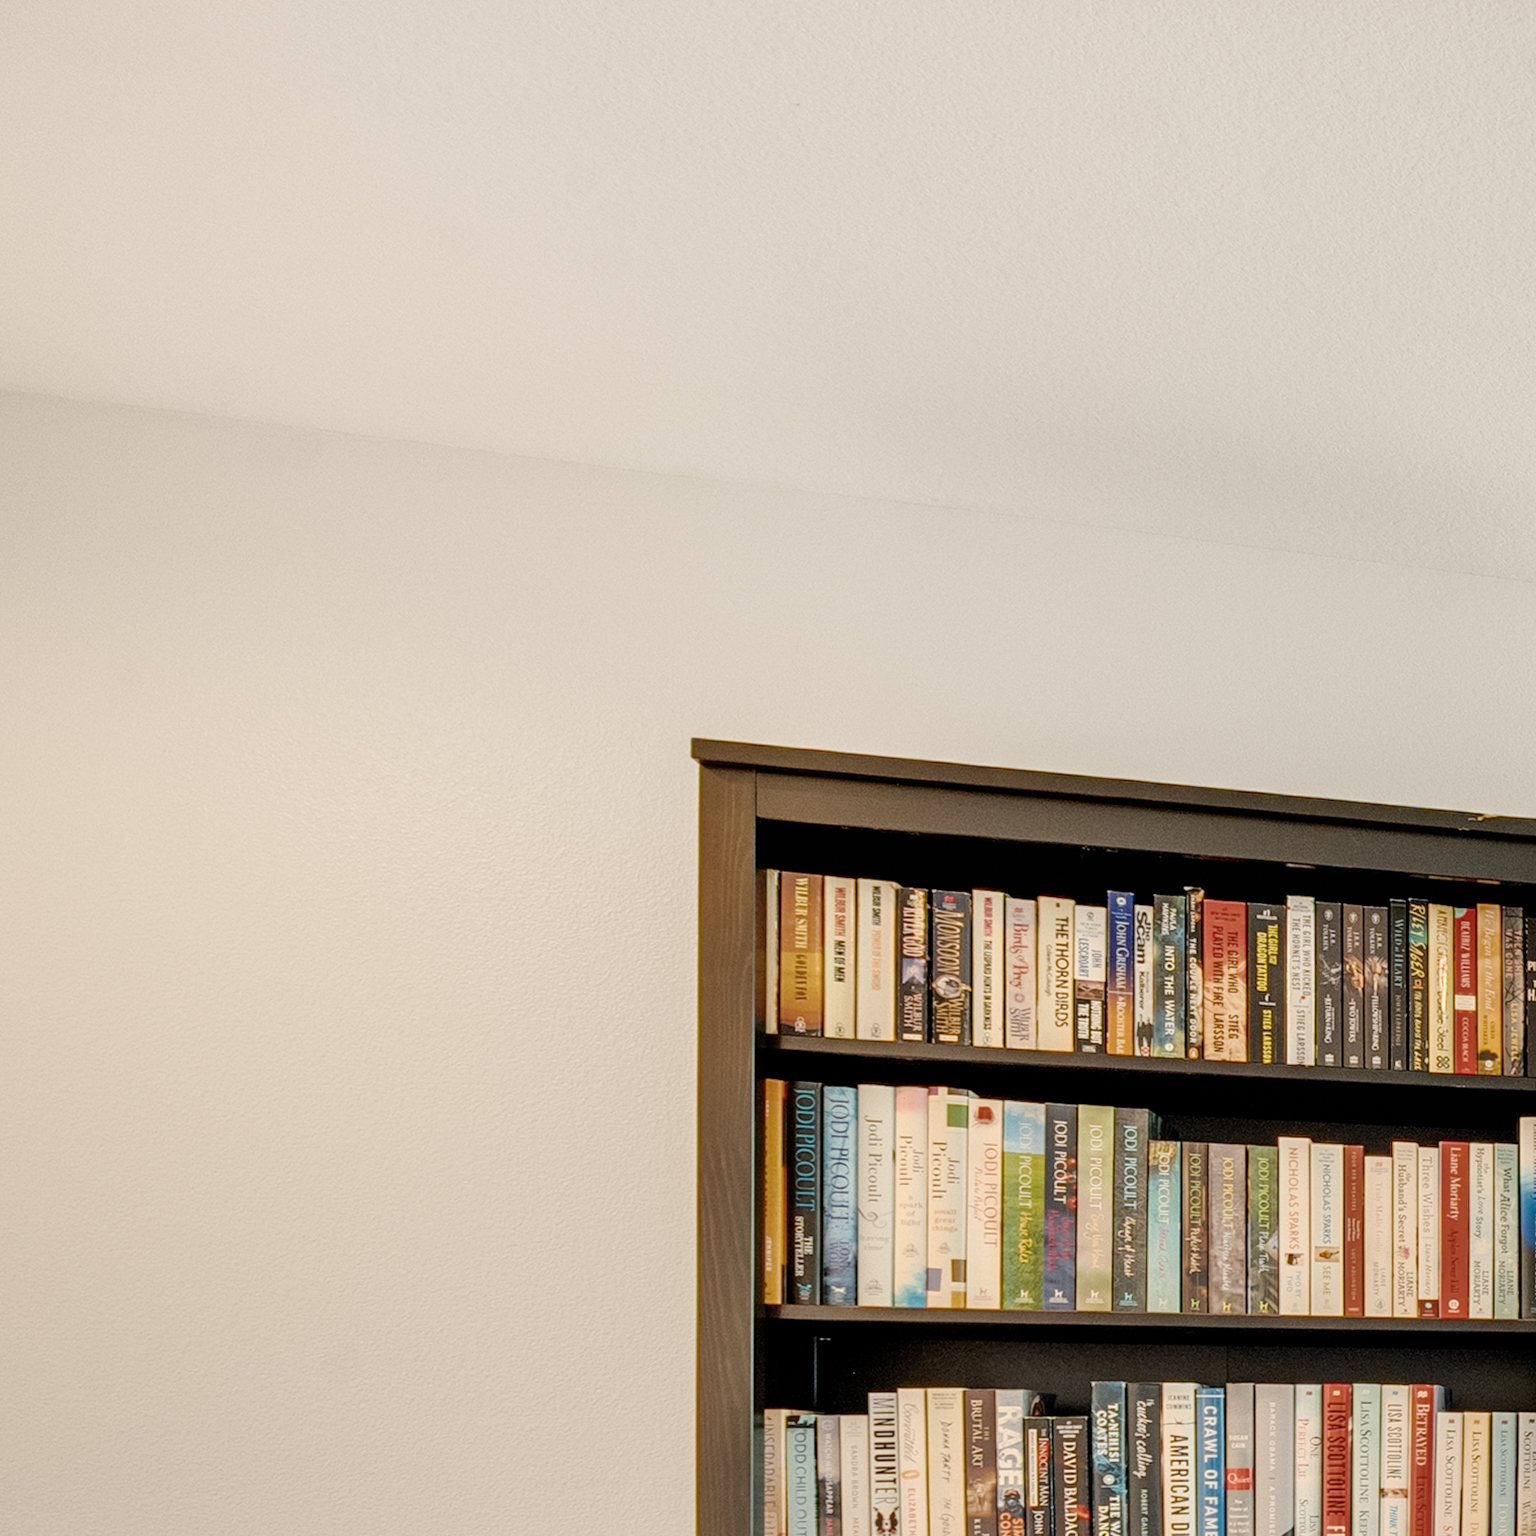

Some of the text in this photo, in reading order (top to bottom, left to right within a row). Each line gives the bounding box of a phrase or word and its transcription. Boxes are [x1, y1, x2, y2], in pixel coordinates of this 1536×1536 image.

[796, 878, 808, 949] WILBUR SMITH
[835, 888, 846, 912] WILBUR
[835, 914, 845, 936] SMITH
[1161, 903, 1169, 935] HAWKINS
[835, 940, 845, 956] MEN
[934, 909, 964, 975] MONSOON
[1116, 917, 1129, 988] JOHN GRISHAM
[1137, 911, 1146, 964] Scam
[1227, 932, 1239, 993] THE GIRL WHO
[1257, 932, 1267, 992] DRAGON TATTOO
[1411, 904, 1426, 979] RILEY SAGER
[835, 968, 845, 982] MEN
[1055, 917, 1069, 1027] THE THORN BIRDS
[1165, 945, 1175, 1035] INTO THE WATER
[1213, 926, 1224, 1007] PLAYED WITH FIRE
[934, 1001, 947, 1033] SMITH
[949, 994, 964, 1034] WILBUR
[1116, 1002, 1125, 1054] ROOSTER BAR
[1213, 1013, 1224, 1053] LARSSON
[1229, 1014, 1238, 1039] STIEG
[794, 1089, 815, 1211] JODI PICOULT
[865, 1116, 882, 1202] Jodi Picoult
[1053, 1120, 1068, 1147] JODI
[1450, 1147, 1461, 1175] Liane
[1018, 1155, 1032, 1208] PICOULT
[1054, 1151, 1068, 1204] PICOULT
[1288, 1147, 1300, 1249] NICHOLAS SPARKS
[1422, 1157, 1433, 1233] Three Wishes
[1447, 1176, 1461, 1220] Moriarty
[1500, 1168, 1513, 1254] What Alice Forgot
[795, 1216, 804, 1277] STORYTELLER
[971, 1399, 983, 1468] BRUTAL ART
[1097, 1409, 1107, 1456] COATES
[1203, 1405, 1218, 1463] CRAWL
[1327, 1402, 1346, 1431] LISA
[1416, 1403, 1430, 1466] BETRAYED
[873, 1398, 898, 1505] MINDHUNTER
[999, 1405, 1024, 1485] RAGE
[1063, 1442, 1077, 1484] DAVID
[795, 1470, 807, 1505] CHILD
[1170, 1434, 1190, 1516] AMERICAN
[1204, 1469, 1218, 1490] OF
[1327, 1433, 1346, 1517] SCOTTOLINE
[908, 1488, 916, 1536] ELIZABETH
